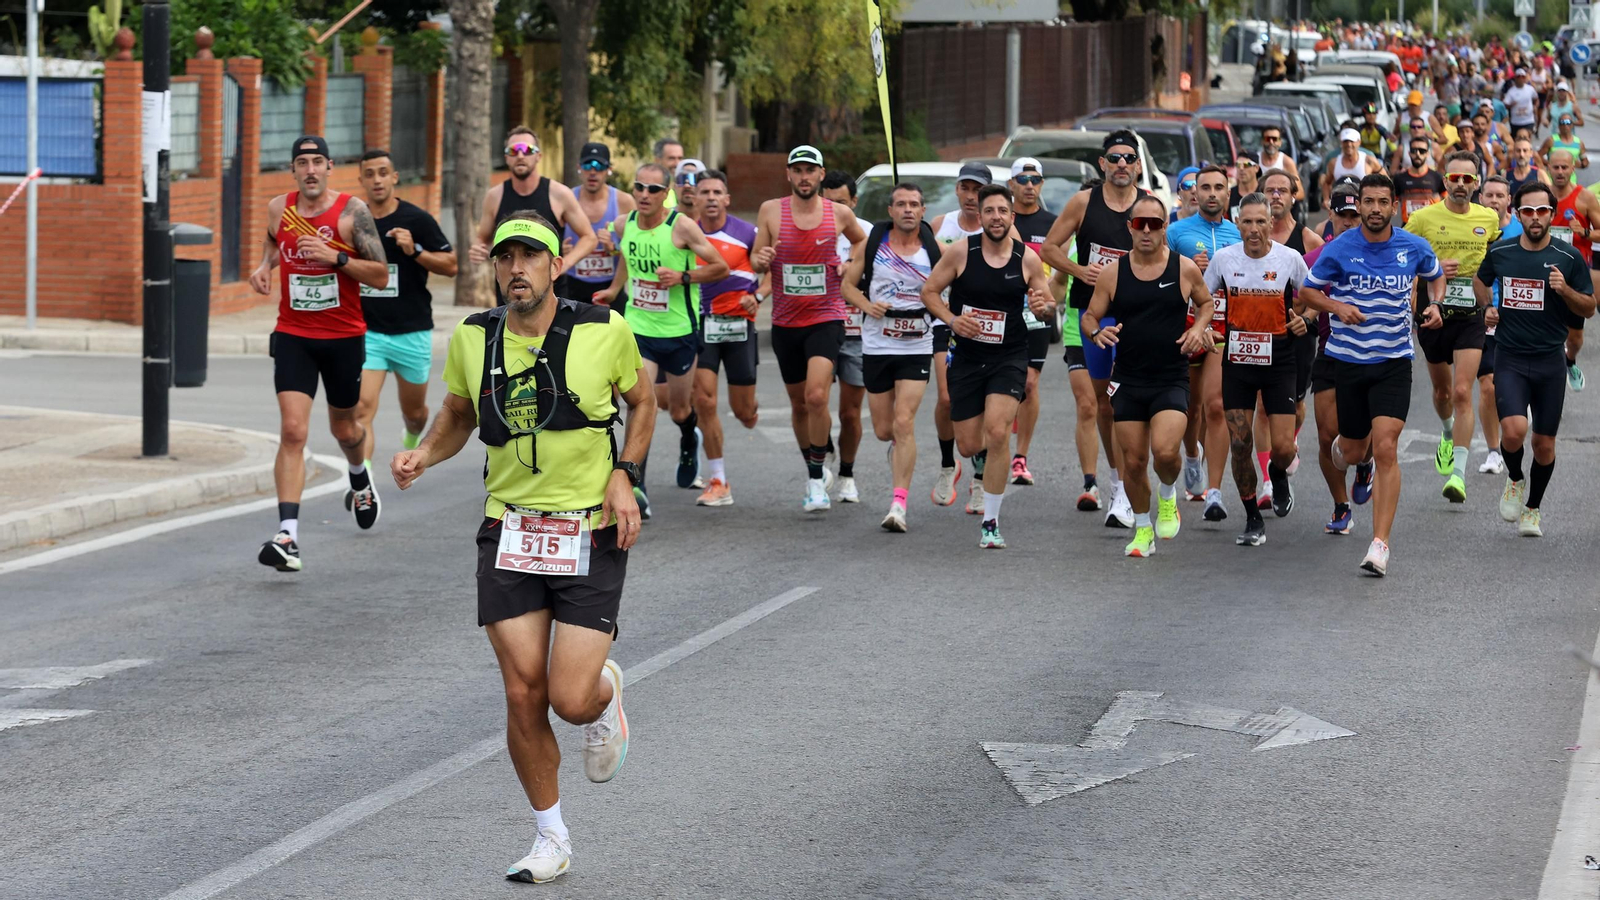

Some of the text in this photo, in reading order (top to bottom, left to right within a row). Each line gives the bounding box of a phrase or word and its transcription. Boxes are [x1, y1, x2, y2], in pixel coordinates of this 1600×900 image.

[628, 241, 660, 258] RUN
[585, 259, 604, 268] 193
[628, 258, 662, 274] RUN
[797, 275, 812, 285] 90
[305, 288, 322, 299] 46
[639, 289, 658, 299] 499
[1449, 286, 1464, 297] 22
[1512, 288, 1534, 300] 545
[894, 319, 915, 330] 584
[1238, 343, 1261, 354] 289
[520, 534, 561, 556] 515
